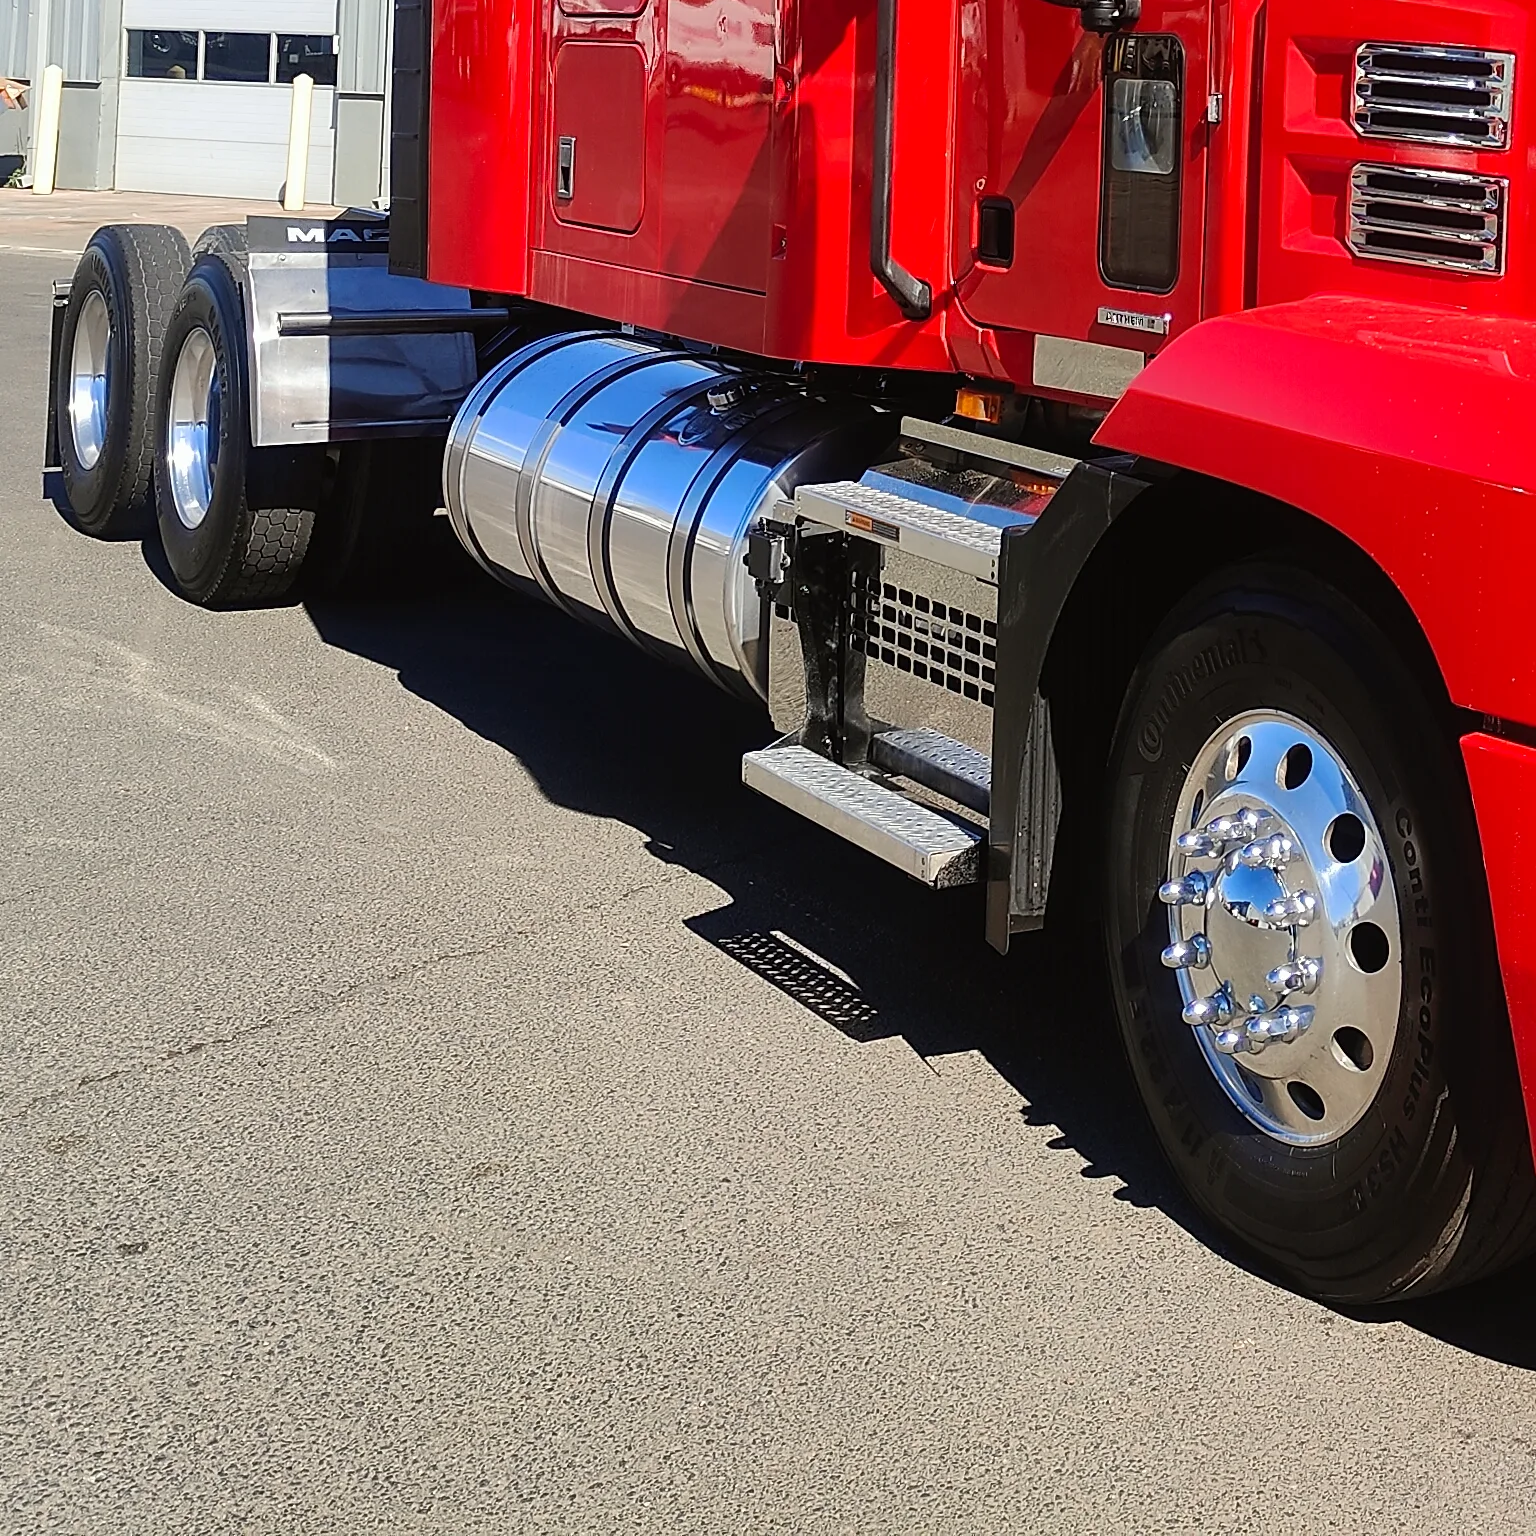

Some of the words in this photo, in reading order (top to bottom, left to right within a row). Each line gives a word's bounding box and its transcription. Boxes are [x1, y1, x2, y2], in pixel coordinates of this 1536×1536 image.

[286, 226, 389, 243] MAC
[1393, 807, 1434, 926] Conti
[1402, 946, 1436, 1122] EcoPlus
